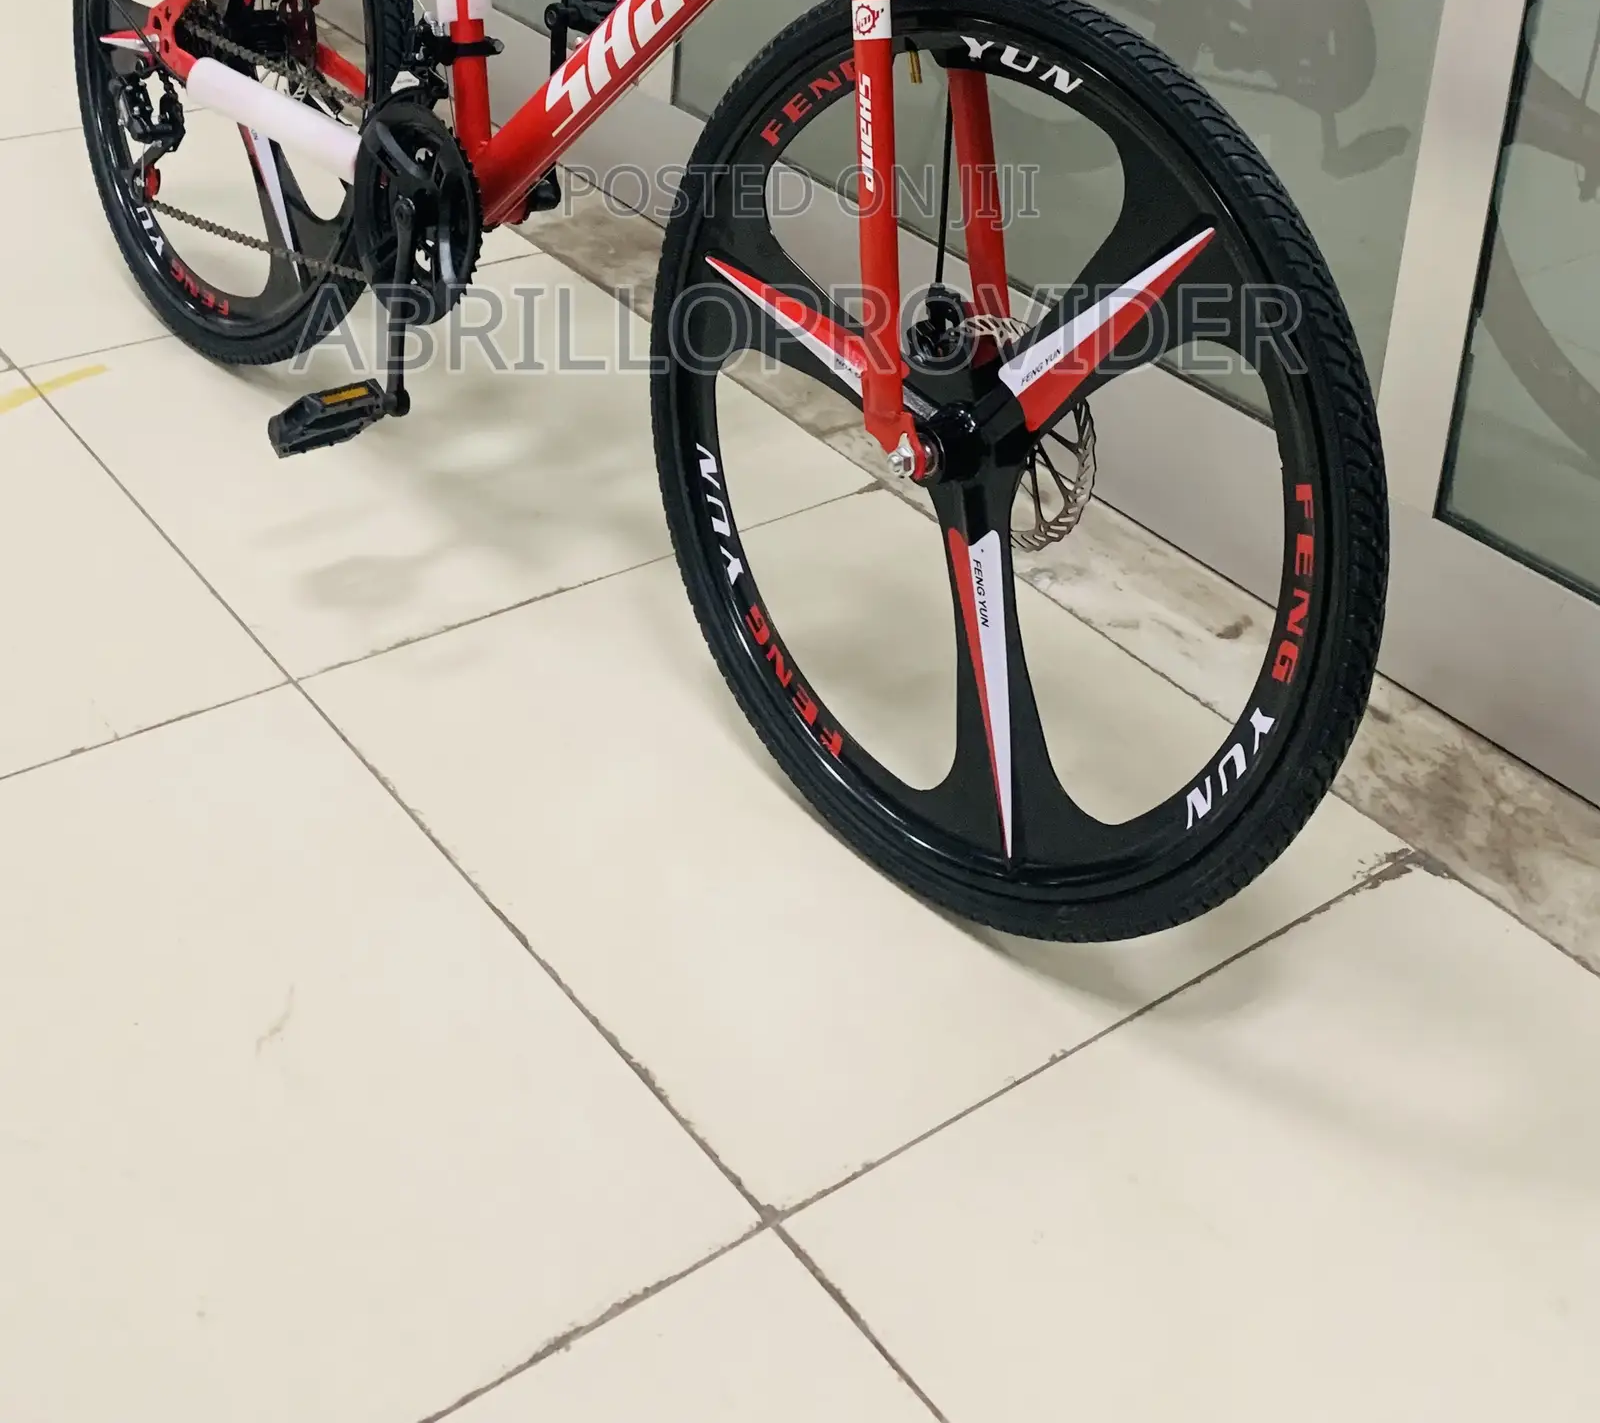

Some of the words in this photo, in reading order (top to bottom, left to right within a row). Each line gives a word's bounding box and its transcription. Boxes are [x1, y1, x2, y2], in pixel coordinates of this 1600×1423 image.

[960, 35, 1084, 94] YUN
[137, 206, 164, 256] YU
[170, 258, 229, 316] FENG
[1021, 362, 1043, 386] FENG
[1045, 348, 1061, 366] YUN
[696, 443, 744, 585] YUN
[973, 559, 986, 596] FENG
[1272, 484, 1315, 684] FENG
[978, 600, 989, 628] YUN
[746, 602, 843, 758] FENG
[1186, 707, 1275, 830] YUN
